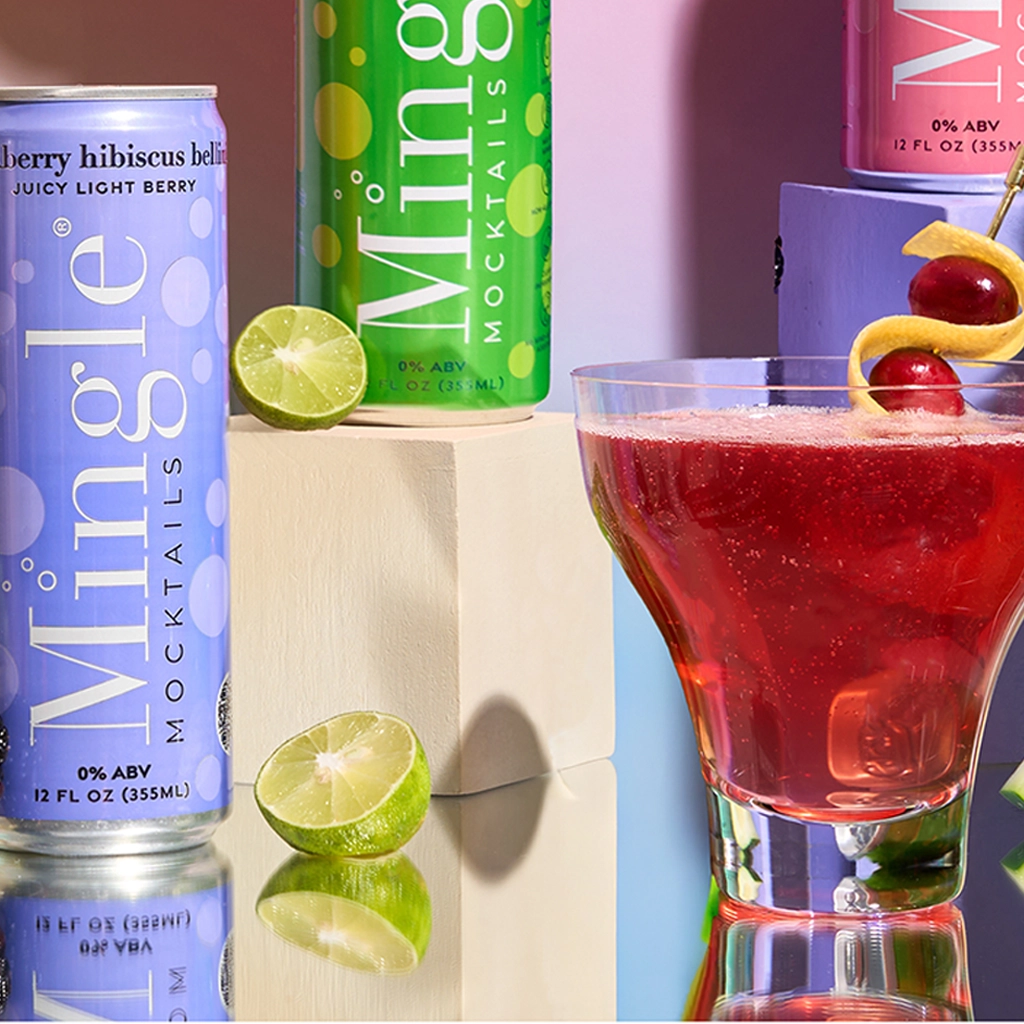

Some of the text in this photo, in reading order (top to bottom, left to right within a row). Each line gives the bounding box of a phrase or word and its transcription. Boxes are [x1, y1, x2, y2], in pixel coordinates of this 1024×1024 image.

[931, 119, 1001, 133] 0% ABV
[894, 138, 907, 151] 12
[913, 138, 933, 151] FL
[940, 139, 964, 152] OZ
[79, 143, 185, 169] hibiscus
[13, 179, 196, 195] JUICY LIGHT BERRY
[484, 78, 508, 344] MOCKTAILS
[397, 360, 466, 373] 0% ABV
[379, 376, 505, 393] FL OZ (355ML)
[163, 457, 185, 744] MOCKTAILS
[77, 763, 152, 781] 0% ABV
[34, 781, 190, 804] 12 FL OZ (355ML)
